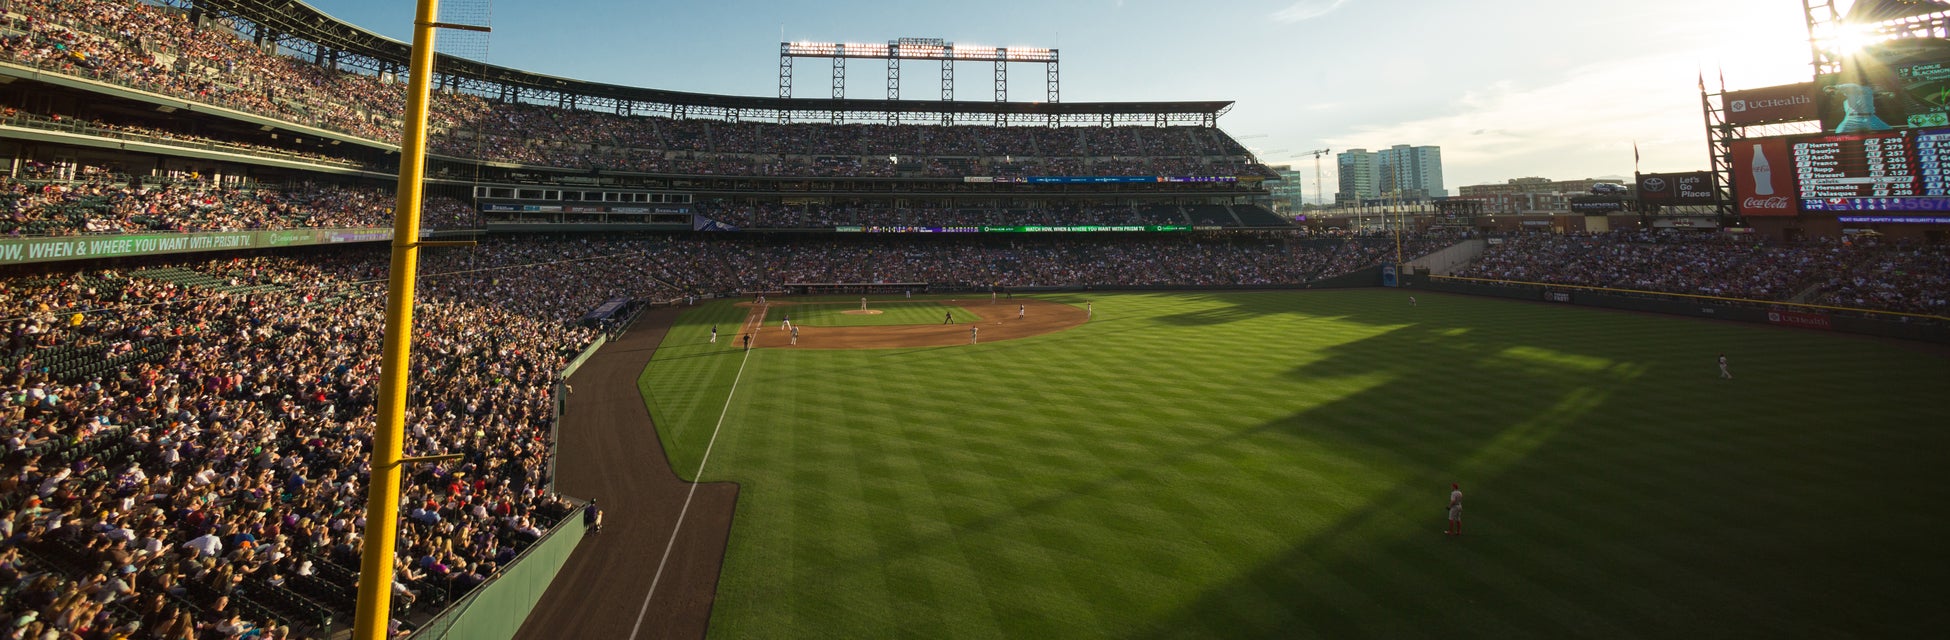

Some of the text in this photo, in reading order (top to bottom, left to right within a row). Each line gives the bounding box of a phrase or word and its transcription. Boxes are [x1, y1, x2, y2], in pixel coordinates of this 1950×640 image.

[1749, 95, 1811, 109] UCHealth
[1680, 176, 1700, 184] Let's
[1744, 196, 1790, 208] Coca-Cola
[29, 242, 74, 258] WHEN
[76, 241, 86, 255] &
[90, 240, 133, 255] WHERE
[135, 238, 157, 252] YOU
[159, 237, 189, 251] WANT
[190, 236, 213, 249] WITH
[214, 235, 238, 247] PRISM
[240, 235, 250, 246] TV.
